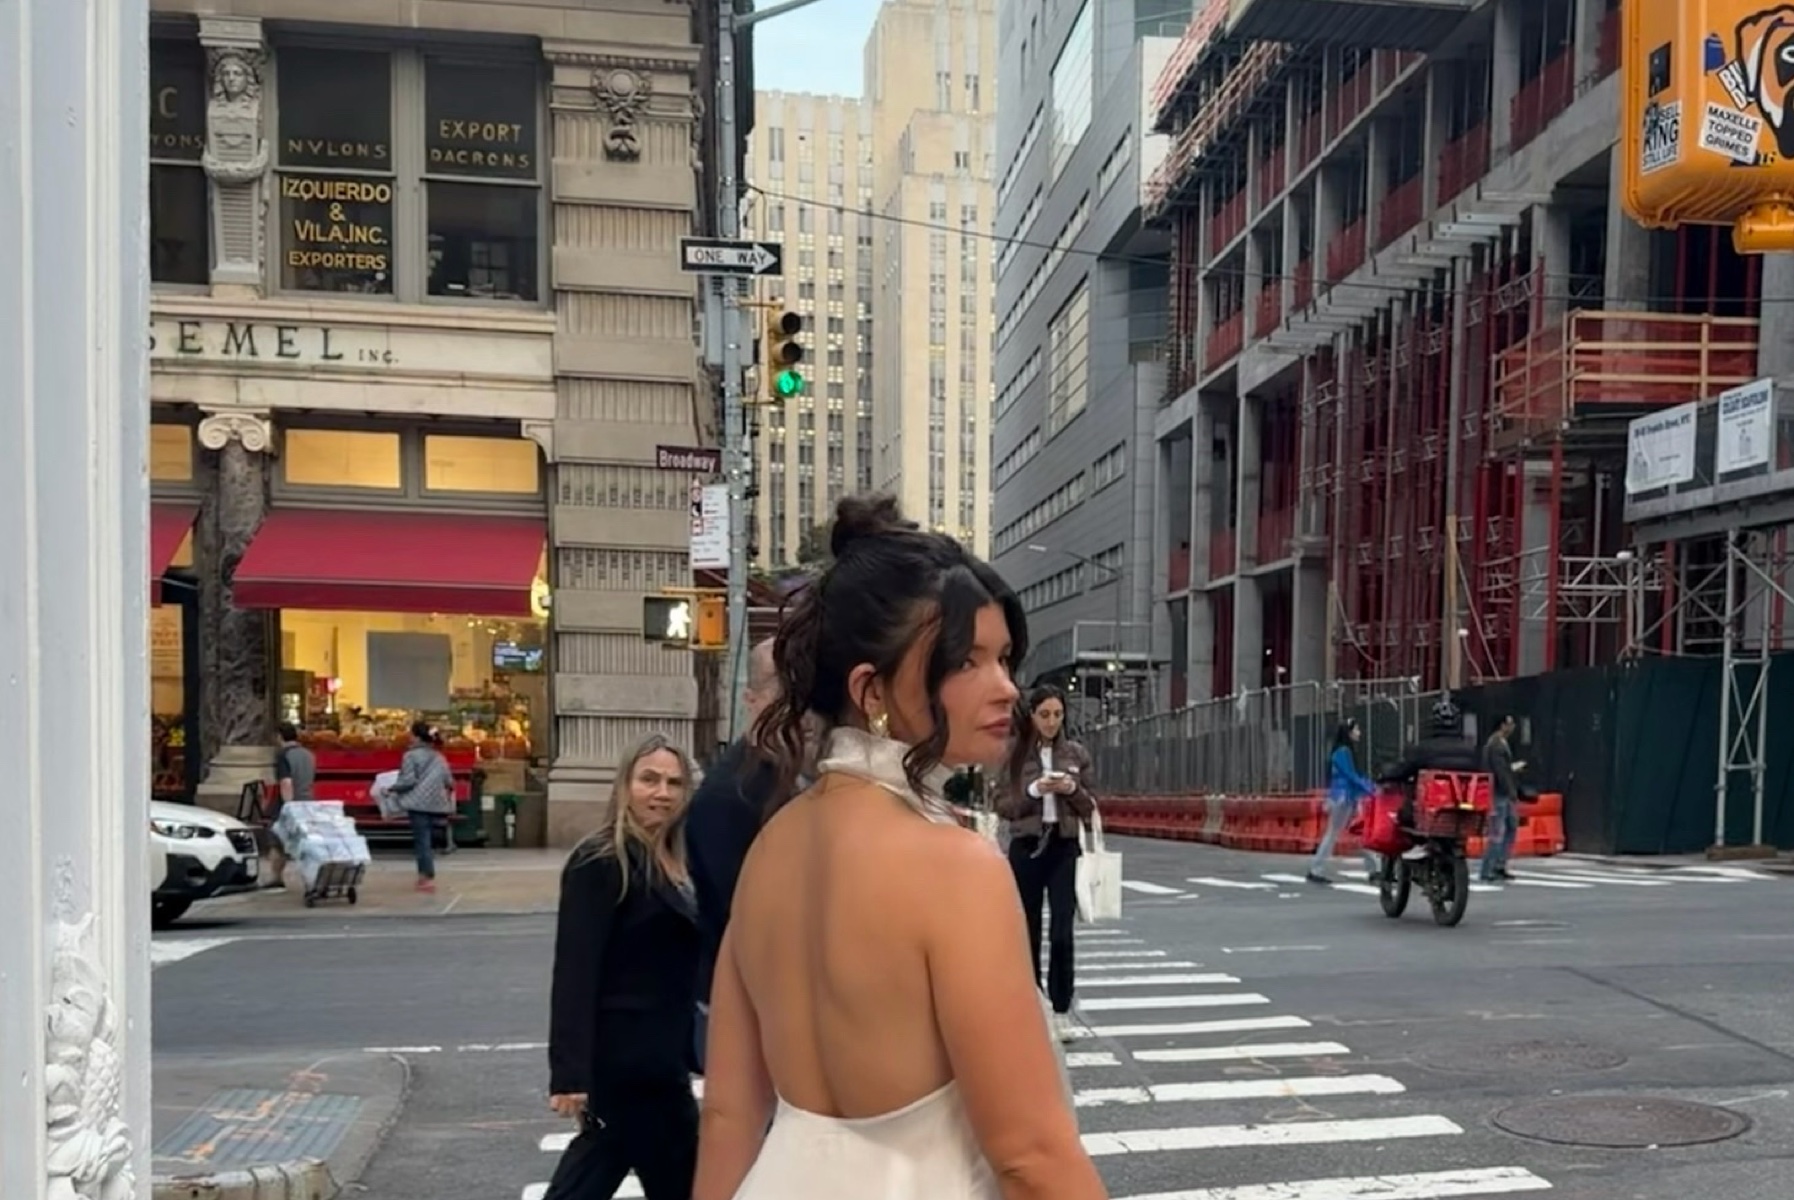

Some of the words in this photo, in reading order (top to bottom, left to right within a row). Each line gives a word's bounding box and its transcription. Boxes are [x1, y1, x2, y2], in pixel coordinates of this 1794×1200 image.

[440, 119, 523, 143] EXPORT
[1707, 106, 1759, 132] MAXELLE
[1708, 119, 1753, 144] TOPPED
[1706, 133, 1749, 157] GRIMES
[430, 148, 530, 168] DACRONS
[282, 176, 391, 203] IZQUIERDO
[329, 202, 346, 221] &
[288, 251, 387, 270] EXPORTERS
[694, 247, 725, 264] ONE
[736, 250, 767, 266] WAY
[358, 347, 400, 365] INC.
[659, 449, 716, 473] Broadway
